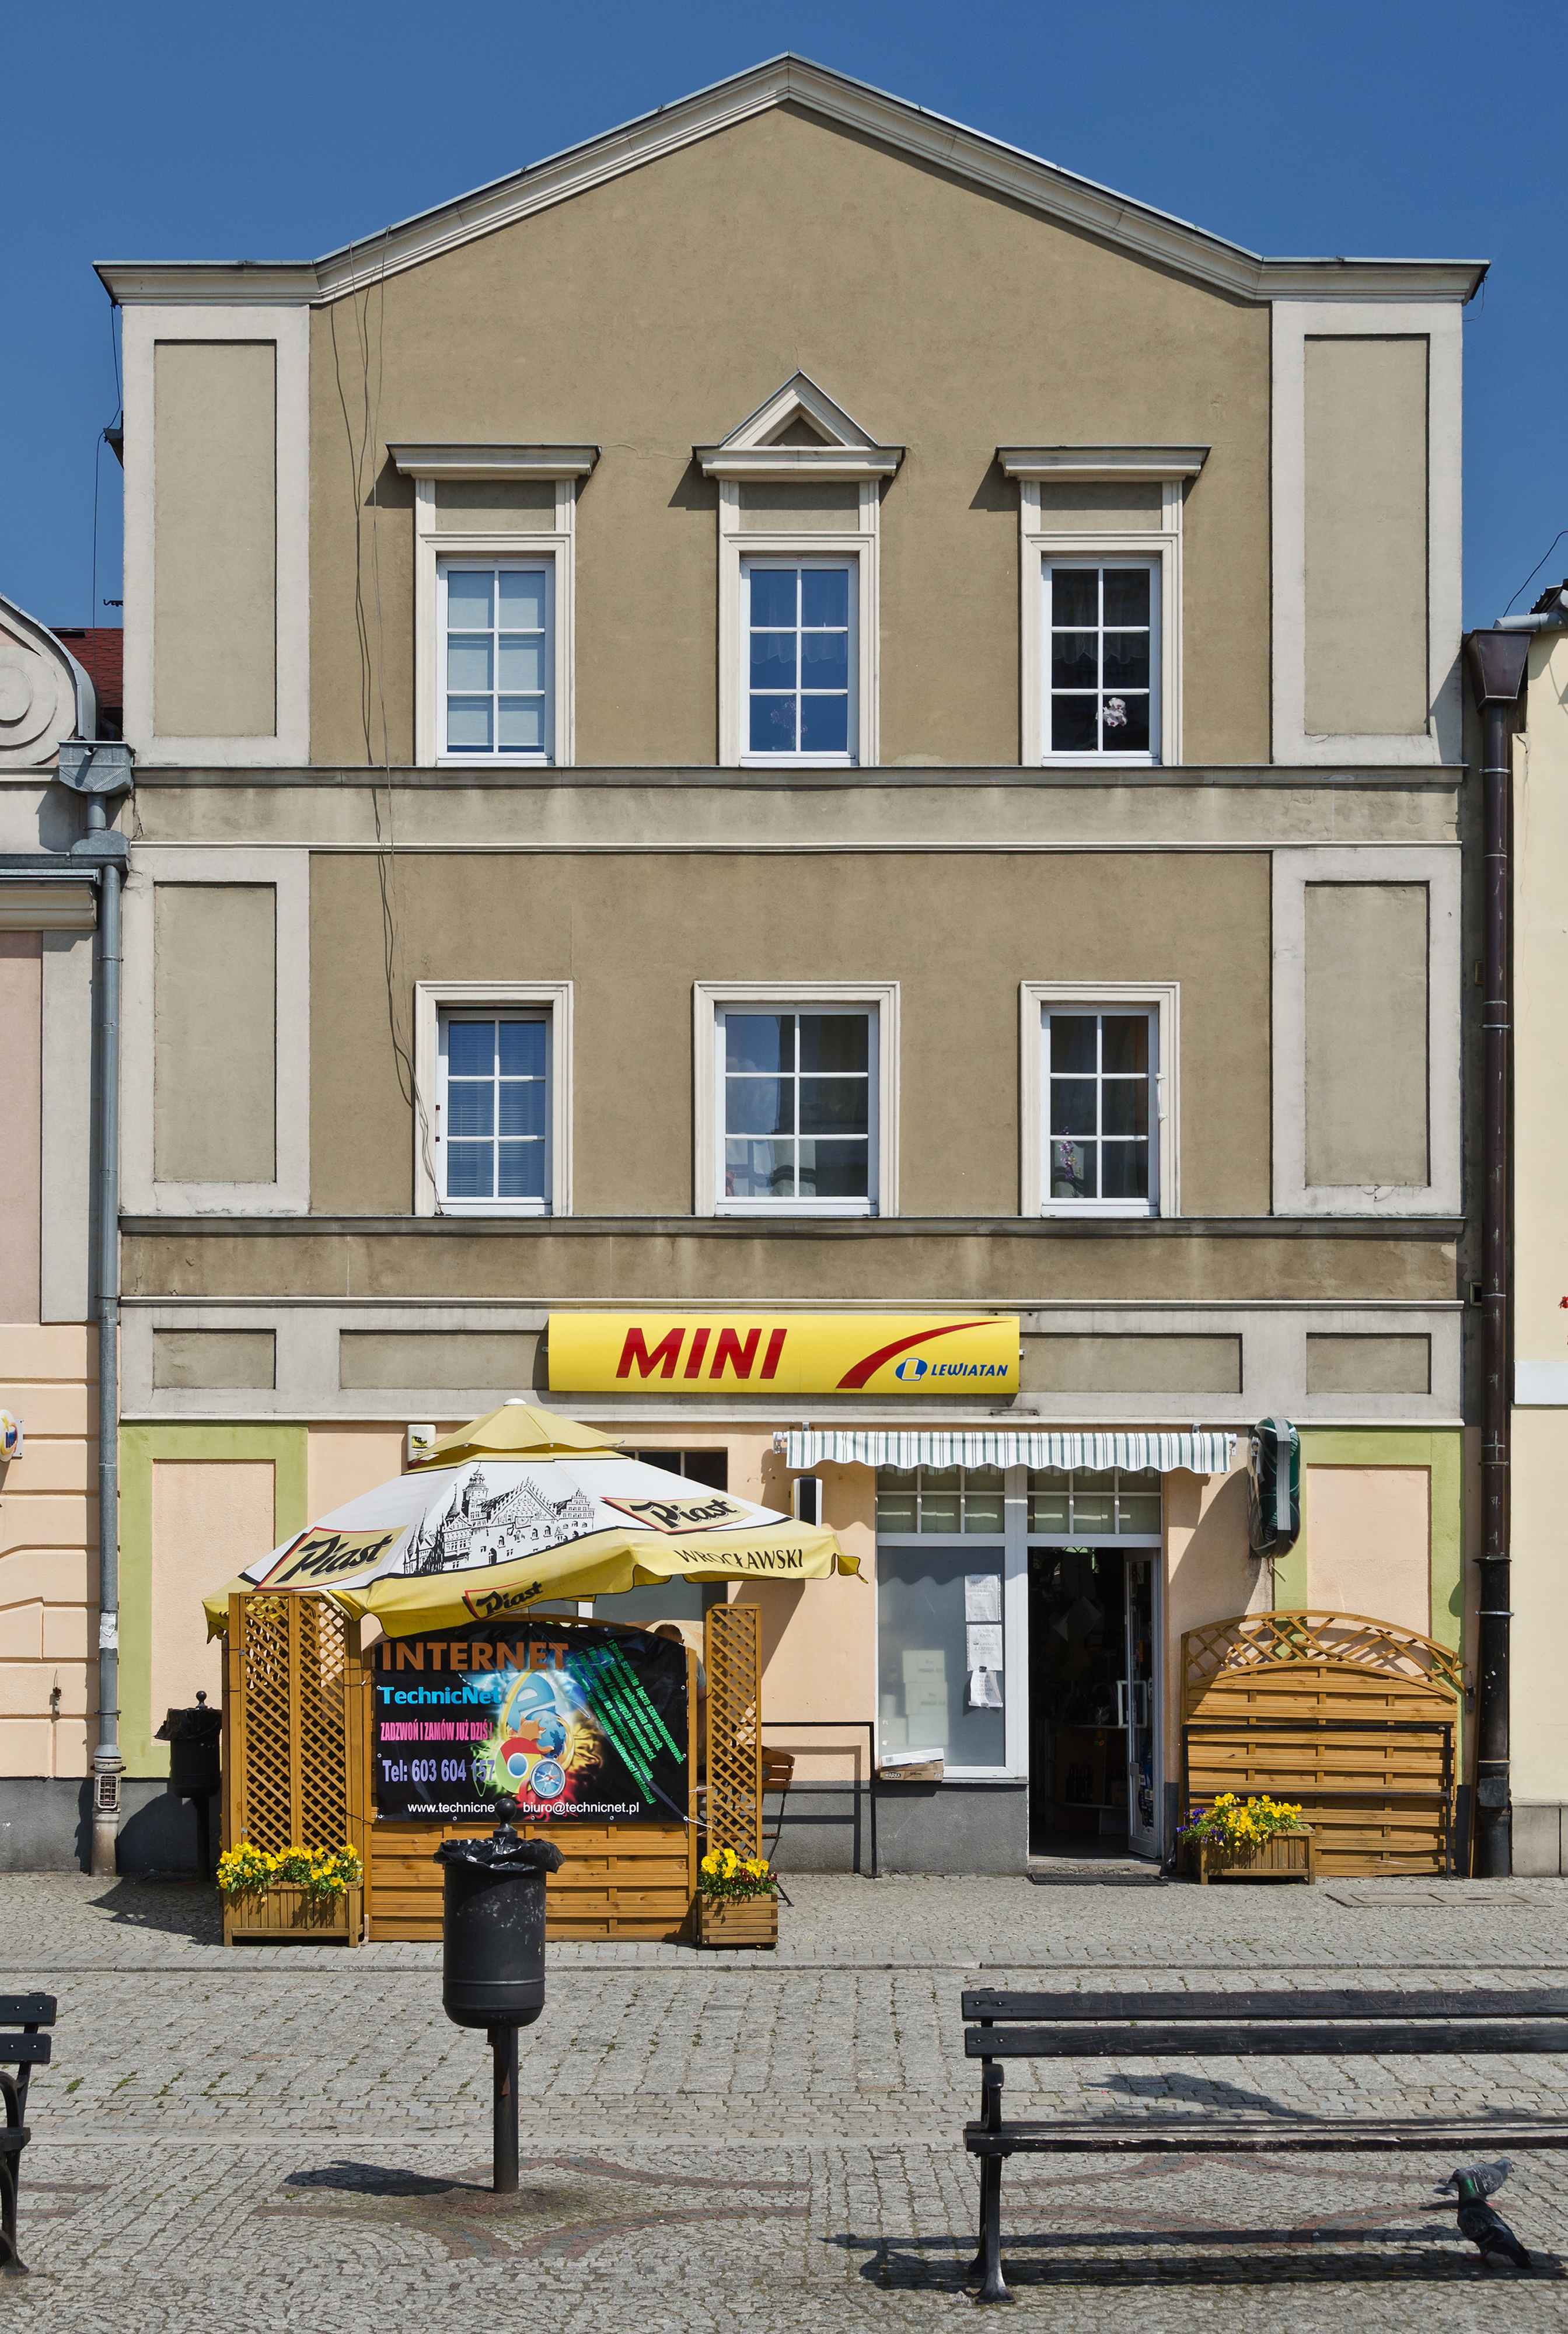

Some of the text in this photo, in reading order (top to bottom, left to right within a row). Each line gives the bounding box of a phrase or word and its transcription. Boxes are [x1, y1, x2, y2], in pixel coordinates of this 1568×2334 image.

[616, 1327, 787, 1379] MINI
[931, 1362, 1008, 1376] LEWIATAN
[629, 1498, 740, 1529] Piast
[273, 1533, 394, 1585] Piast
[672, 1549, 804, 1569] WROCŁAWSKI
[476, 1581, 544, 1615] Piast
[382, 1642, 569, 1670] INTERNET
[379, 1686, 501, 1704] TechnicNet
[602, 1699, 613, 1710] na
[607, 1708, 635, 1749] najwyższym
[620, 1660, 640, 1686] szybkie
[635, 1685, 651, 1706] łącze
[645, 1704, 684, 1765] szerokopasmowe.
[621, 1687, 648, 1725] pobierania
[642, 1722, 663, 1751] danych.
[380, 1719, 418, 1741] ZADZWOŃ
[420, 1722, 423, 1741] I
[424, 1719, 455, 1741] ZAMÓW
[456, 1719, 469, 1741] JUŻ
[470, 1719, 488, 1741] DZIŚ
[626, 1717, 656, 1762] formalności.
[586, 1692, 614, 1735] sprawdzenie
[609, 1734, 638, 1773] możliwości
[631, 1770, 656, 1804] instalacji
[382, 1759, 495, 1782] Tel: 603 604 157
[630, 1748, 654, 1781] poziomie.
[523, 1802, 640, 1815] biuro@technicnet.pl
